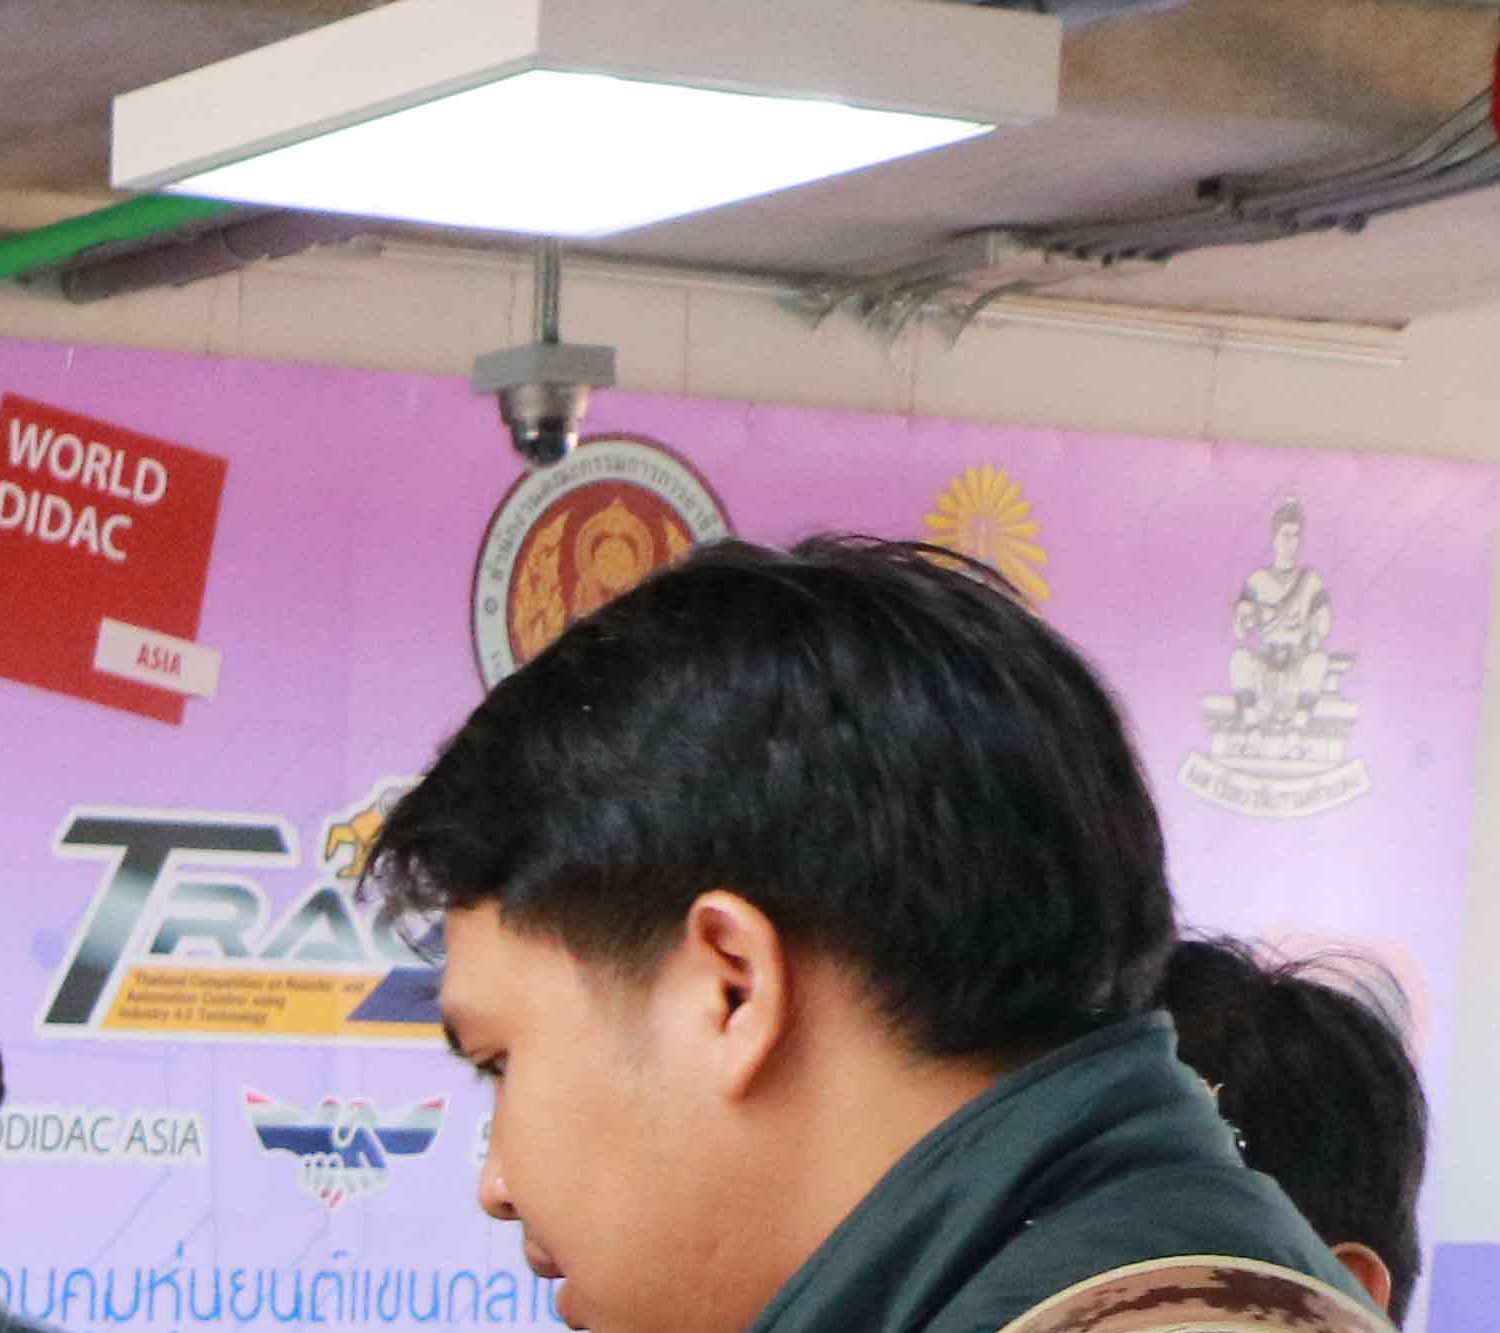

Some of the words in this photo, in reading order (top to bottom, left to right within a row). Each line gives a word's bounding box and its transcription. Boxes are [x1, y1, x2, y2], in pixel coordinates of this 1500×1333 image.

[8, 418, 168, 507] WORLD
[135, 644, 183, 677] ASIA
[125, 1116, 202, 1154] ASIA
